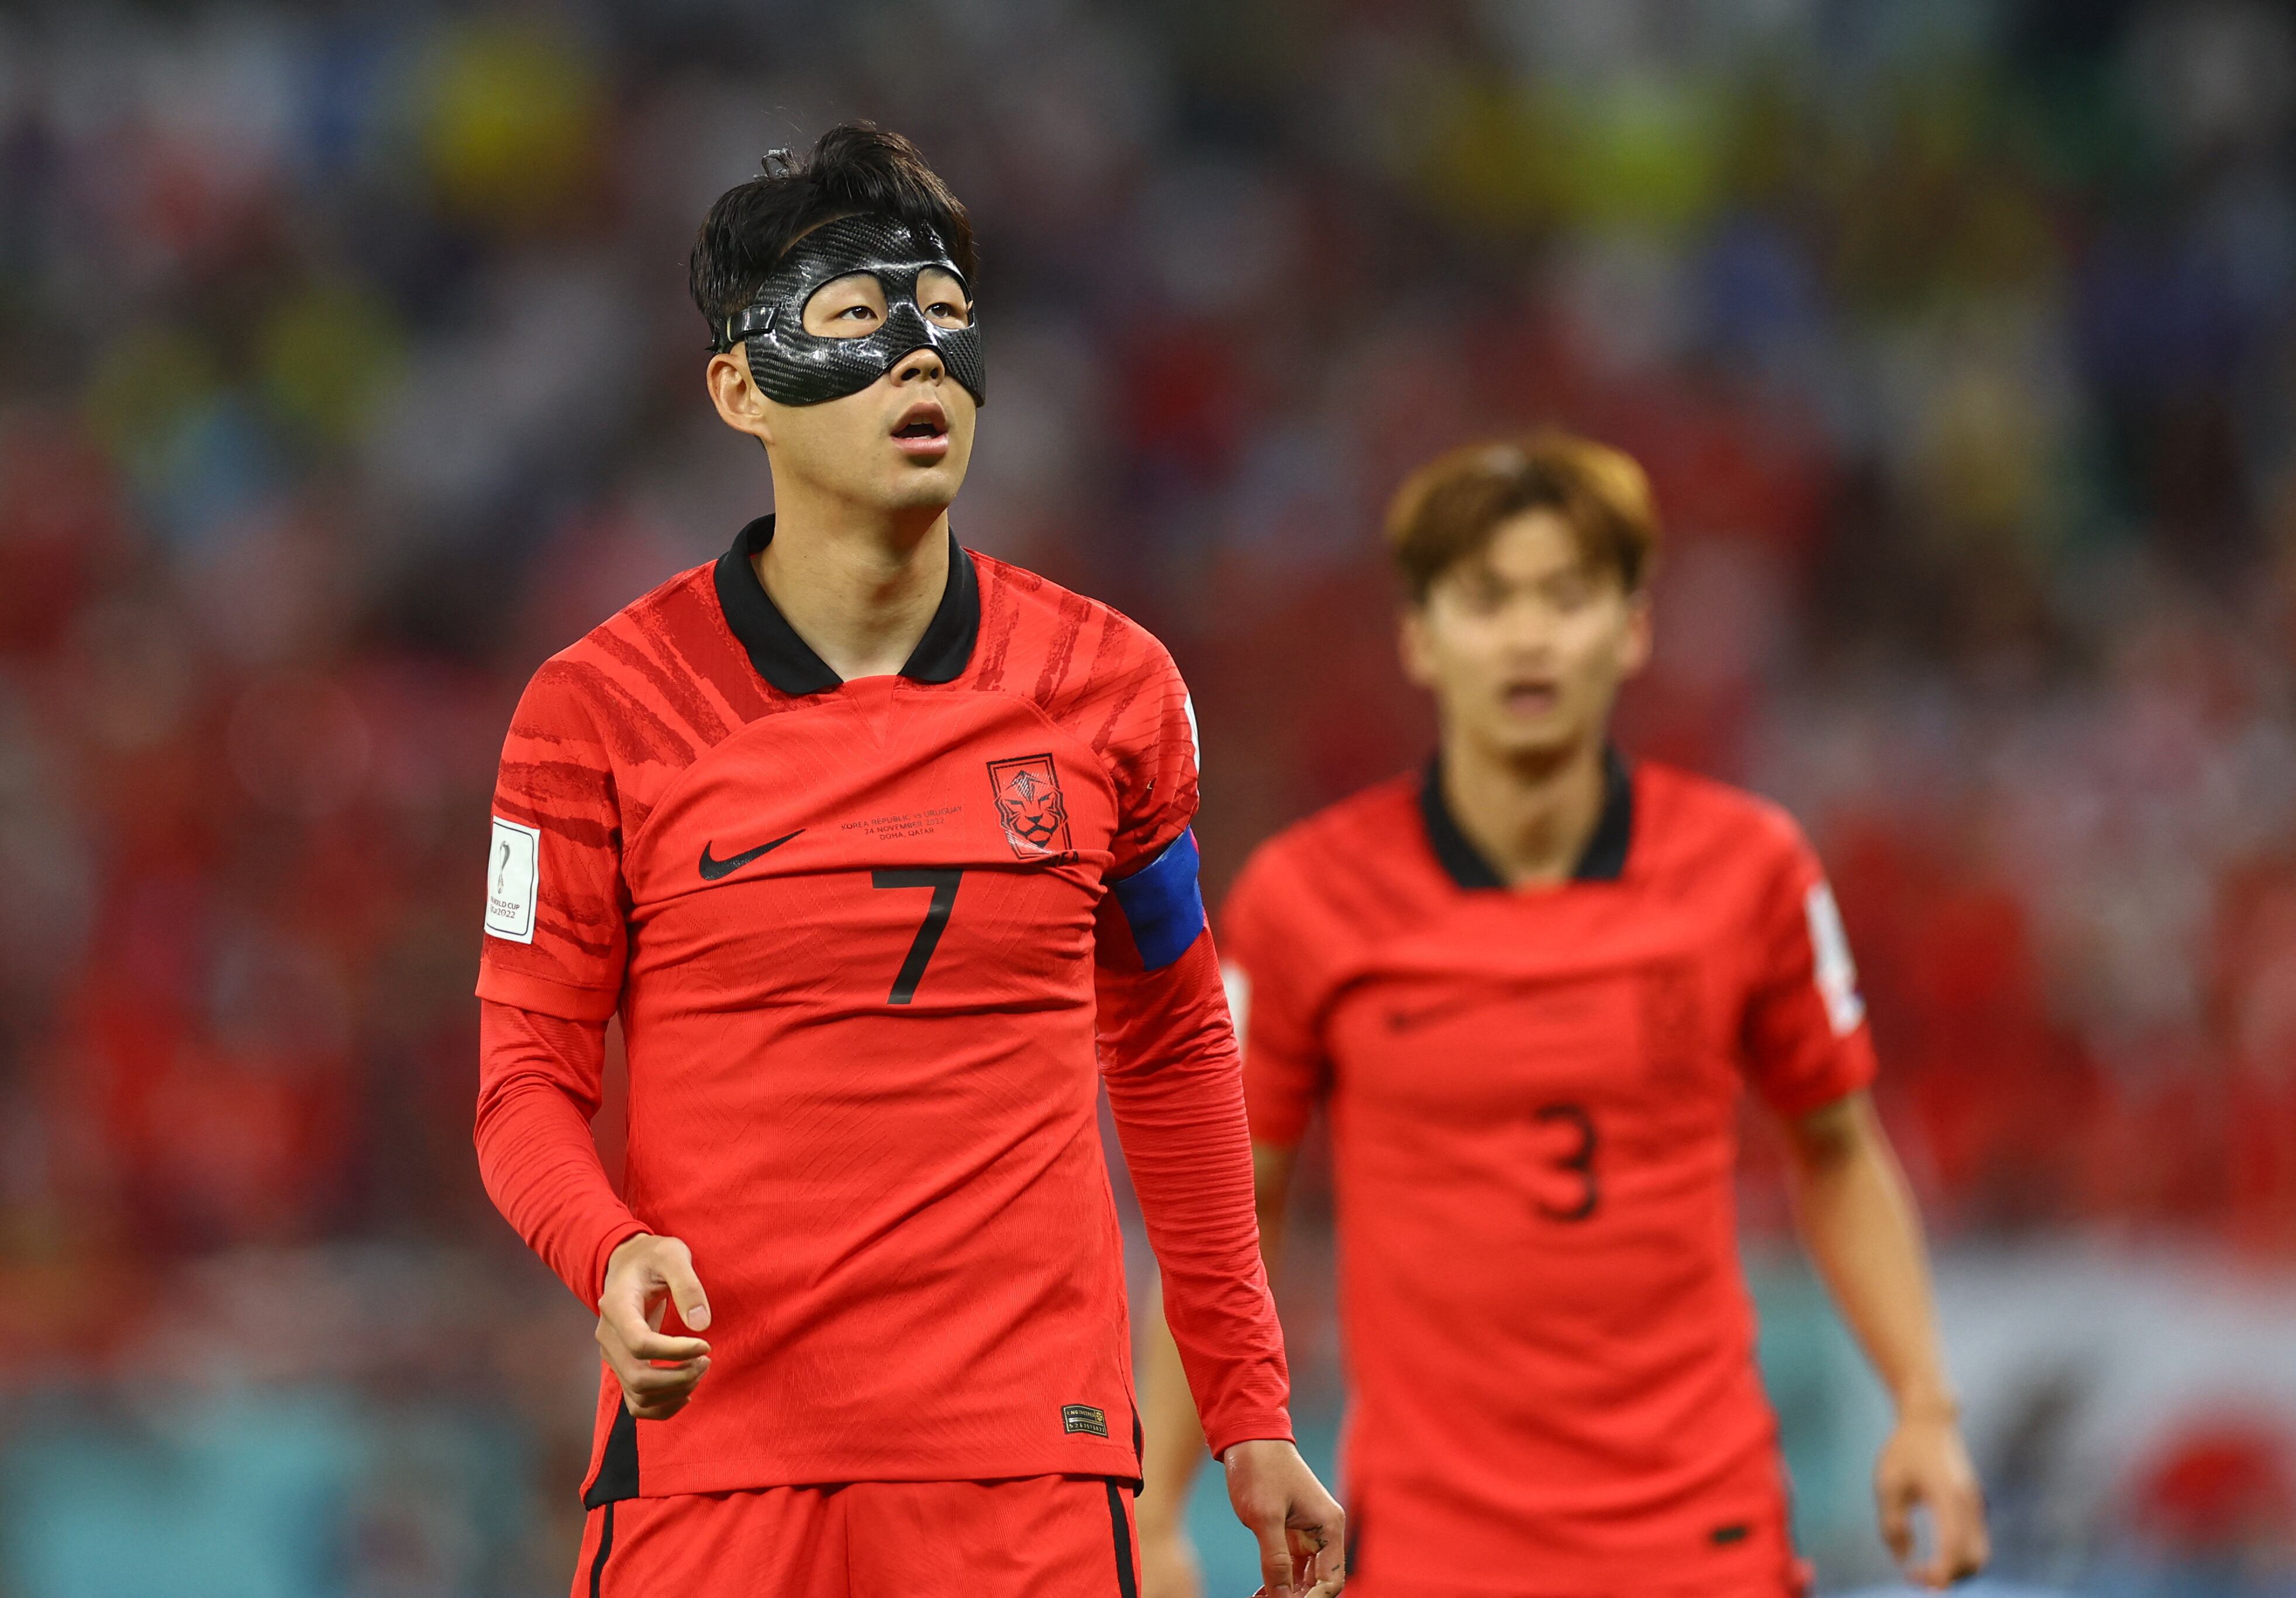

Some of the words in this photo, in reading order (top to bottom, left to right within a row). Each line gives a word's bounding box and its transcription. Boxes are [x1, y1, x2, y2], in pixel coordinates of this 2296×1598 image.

[841, 821, 869, 830] KOREA
[871, 814, 911, 825] REPUBLIC
[923, 806, 962, 817] URUGUAY
[877, 820, 922, 833] NOVEMBER
[908, 827, 935, 836] QATAR
[508, 902, 520, 910] CUP
[871, 870, 963, 1005] 7
[1531, 1102, 1598, 1224] 3
